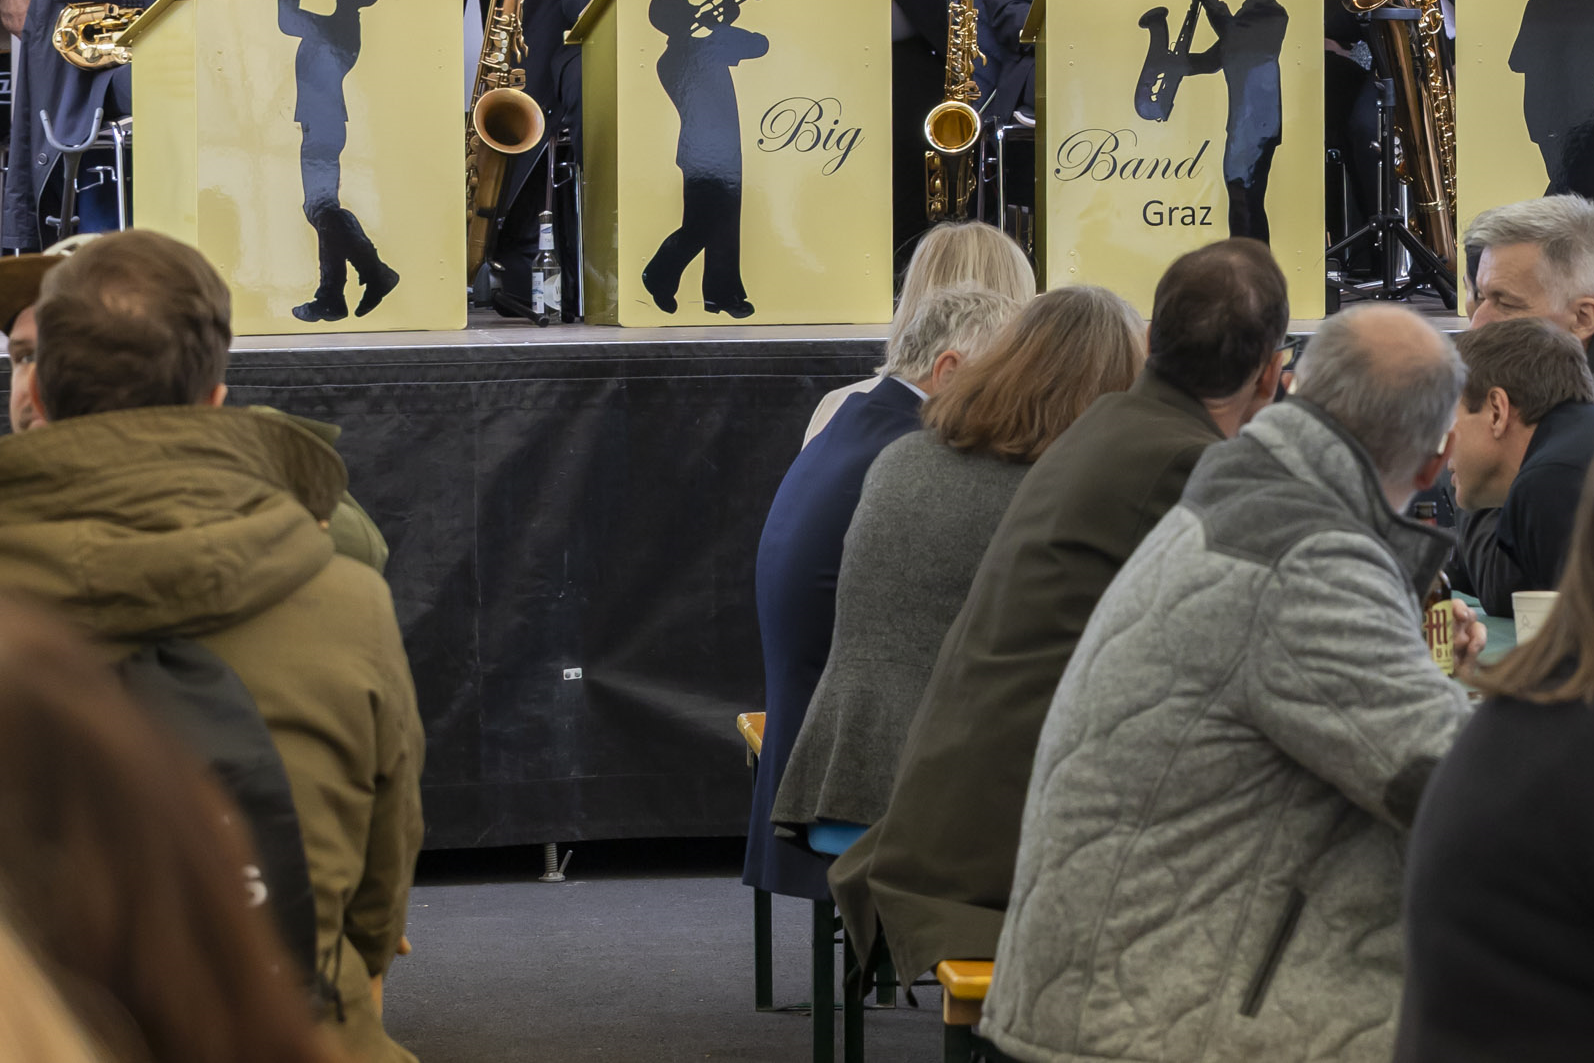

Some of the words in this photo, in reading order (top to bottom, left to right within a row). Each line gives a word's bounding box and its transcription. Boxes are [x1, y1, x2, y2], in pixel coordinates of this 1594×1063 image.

[757, 97, 865, 176] Big
[1054, 128, 1209, 182] Band
[1142, 200, 1212, 228] Graz
